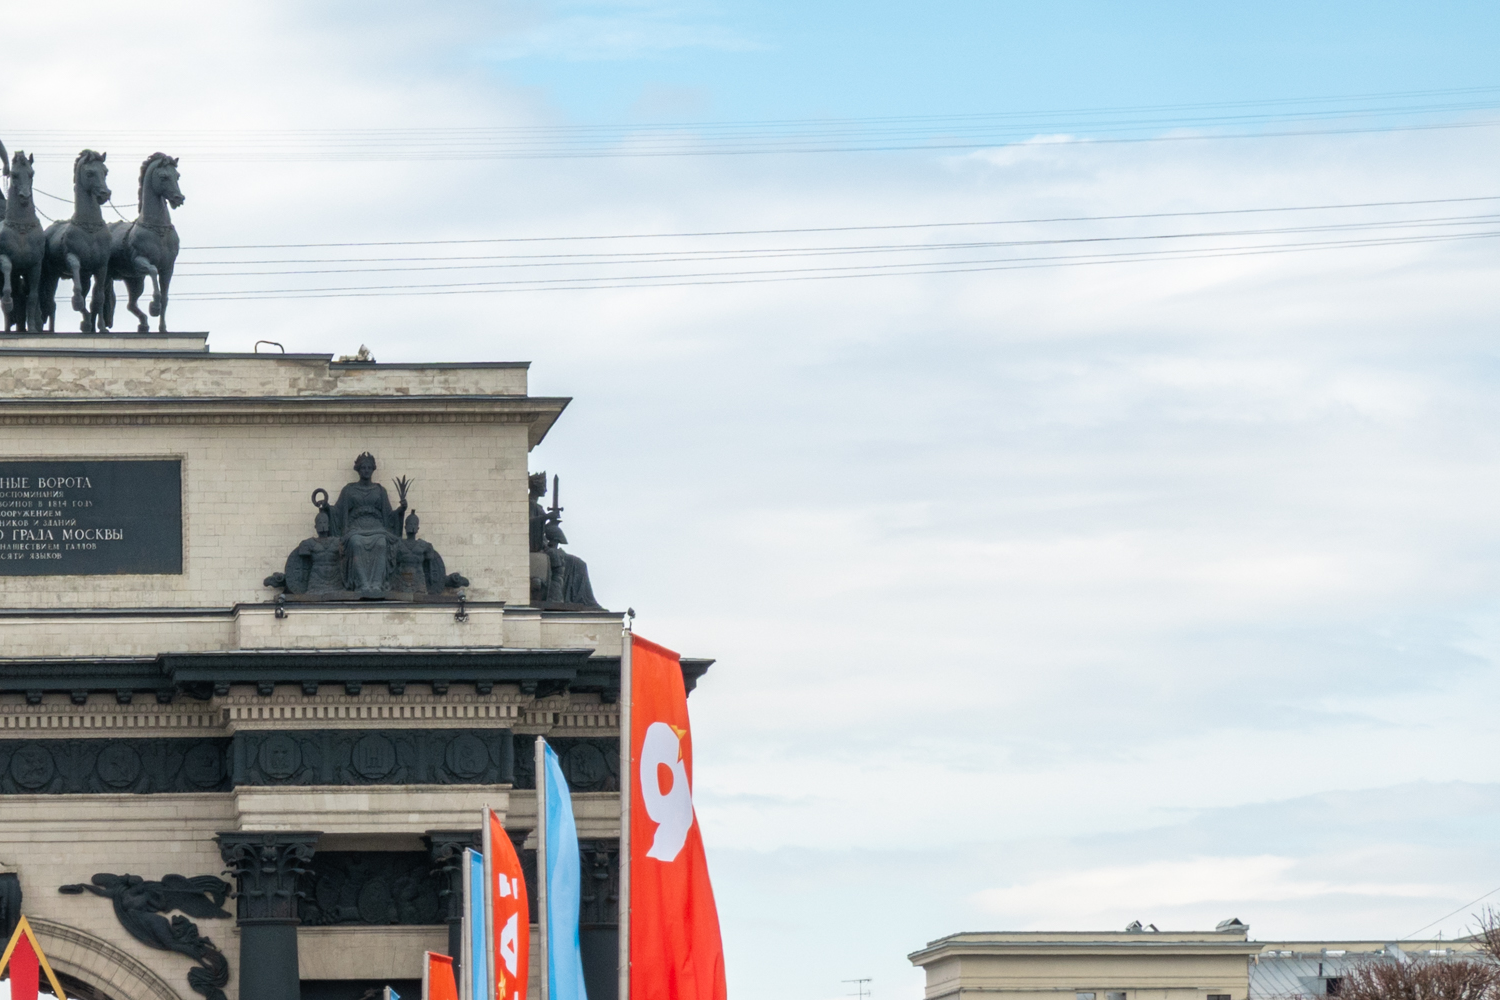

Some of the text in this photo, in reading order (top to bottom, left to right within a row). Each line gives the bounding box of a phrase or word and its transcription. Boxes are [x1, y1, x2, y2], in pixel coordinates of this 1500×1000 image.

[38, 476, 92, 489] ВОРОТА
[12, 529, 54, 541] ГРАДА
[62, 528, 124, 541] МОСКВЫ
[29, 552, 63, 560] ЯЗЫКОВ
[640, 721, 694, 862] 9
